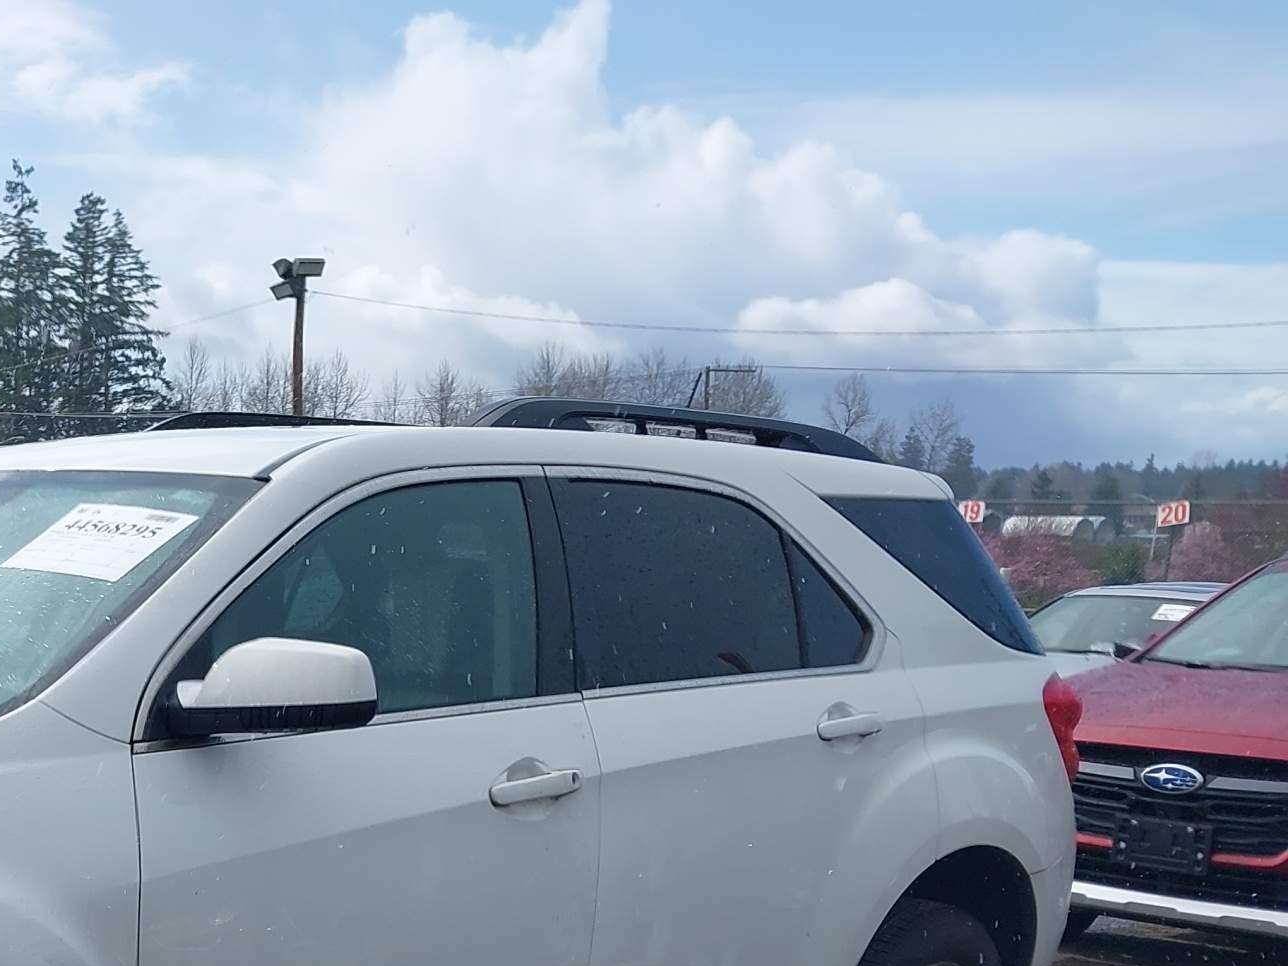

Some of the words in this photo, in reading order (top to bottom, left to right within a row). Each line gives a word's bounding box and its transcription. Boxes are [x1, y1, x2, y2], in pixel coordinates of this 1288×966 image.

[963, 502, 981, 520] 19
[1161, 504, 1187, 524] 20
[64, 519, 164, 539] 44568295
